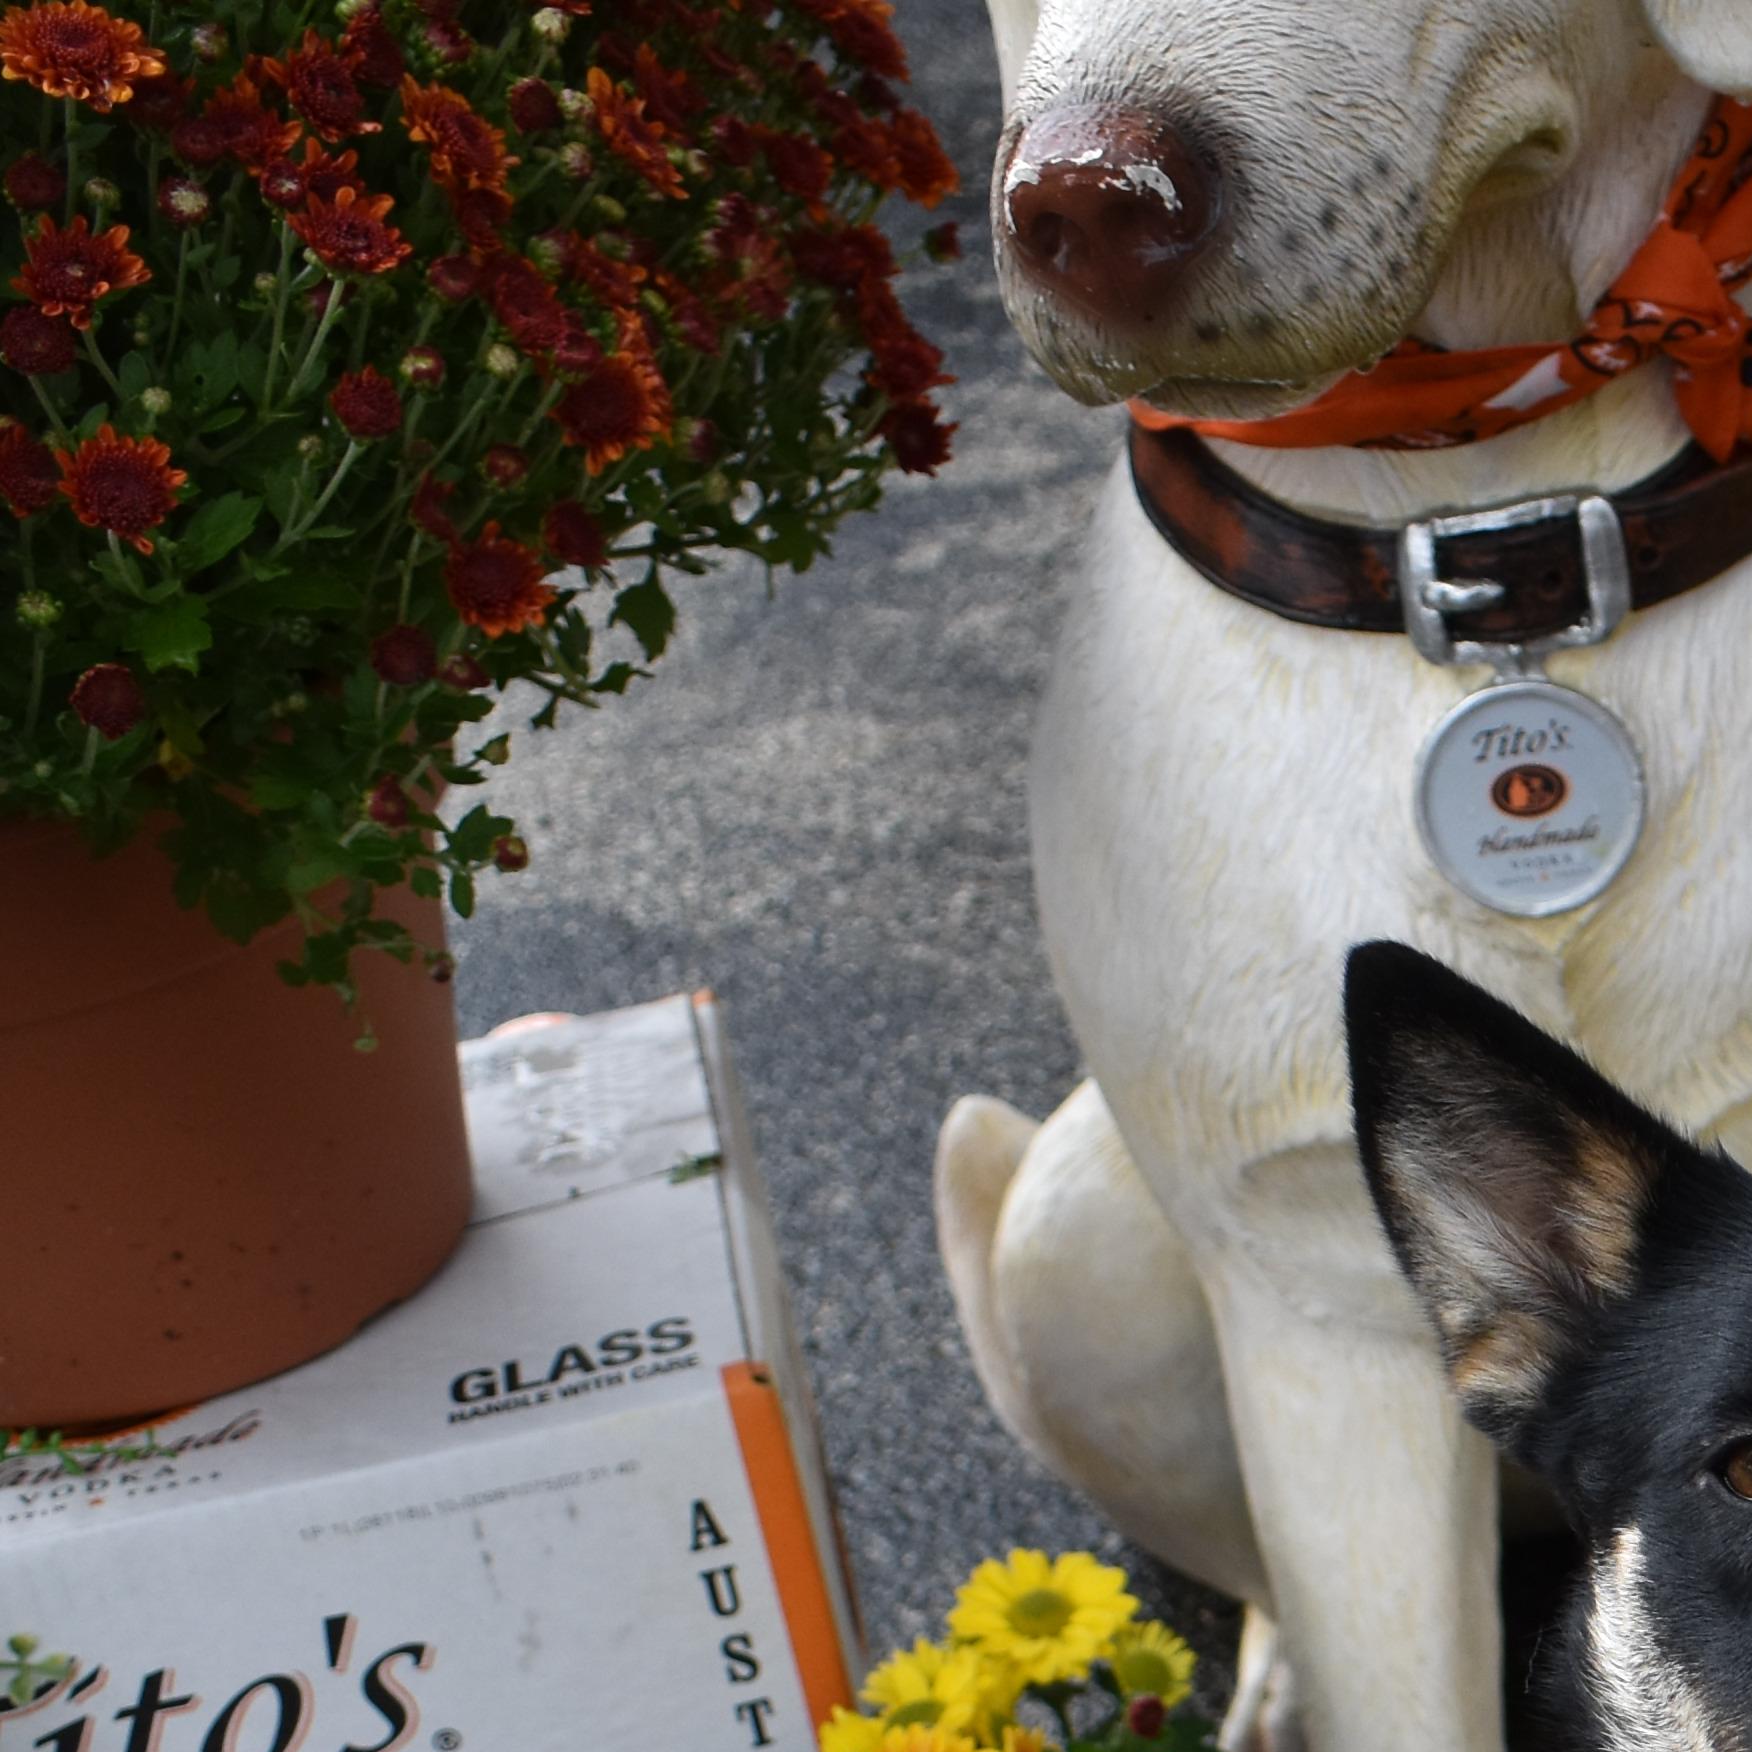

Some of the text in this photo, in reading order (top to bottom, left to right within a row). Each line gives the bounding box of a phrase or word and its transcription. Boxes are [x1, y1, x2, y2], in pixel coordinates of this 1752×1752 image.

[1472, 719, 1569, 762] Tito's
[447, 1352, 701, 1423] HANDLE WITH CARE
[449, 1316, 695, 1403] GLASS
